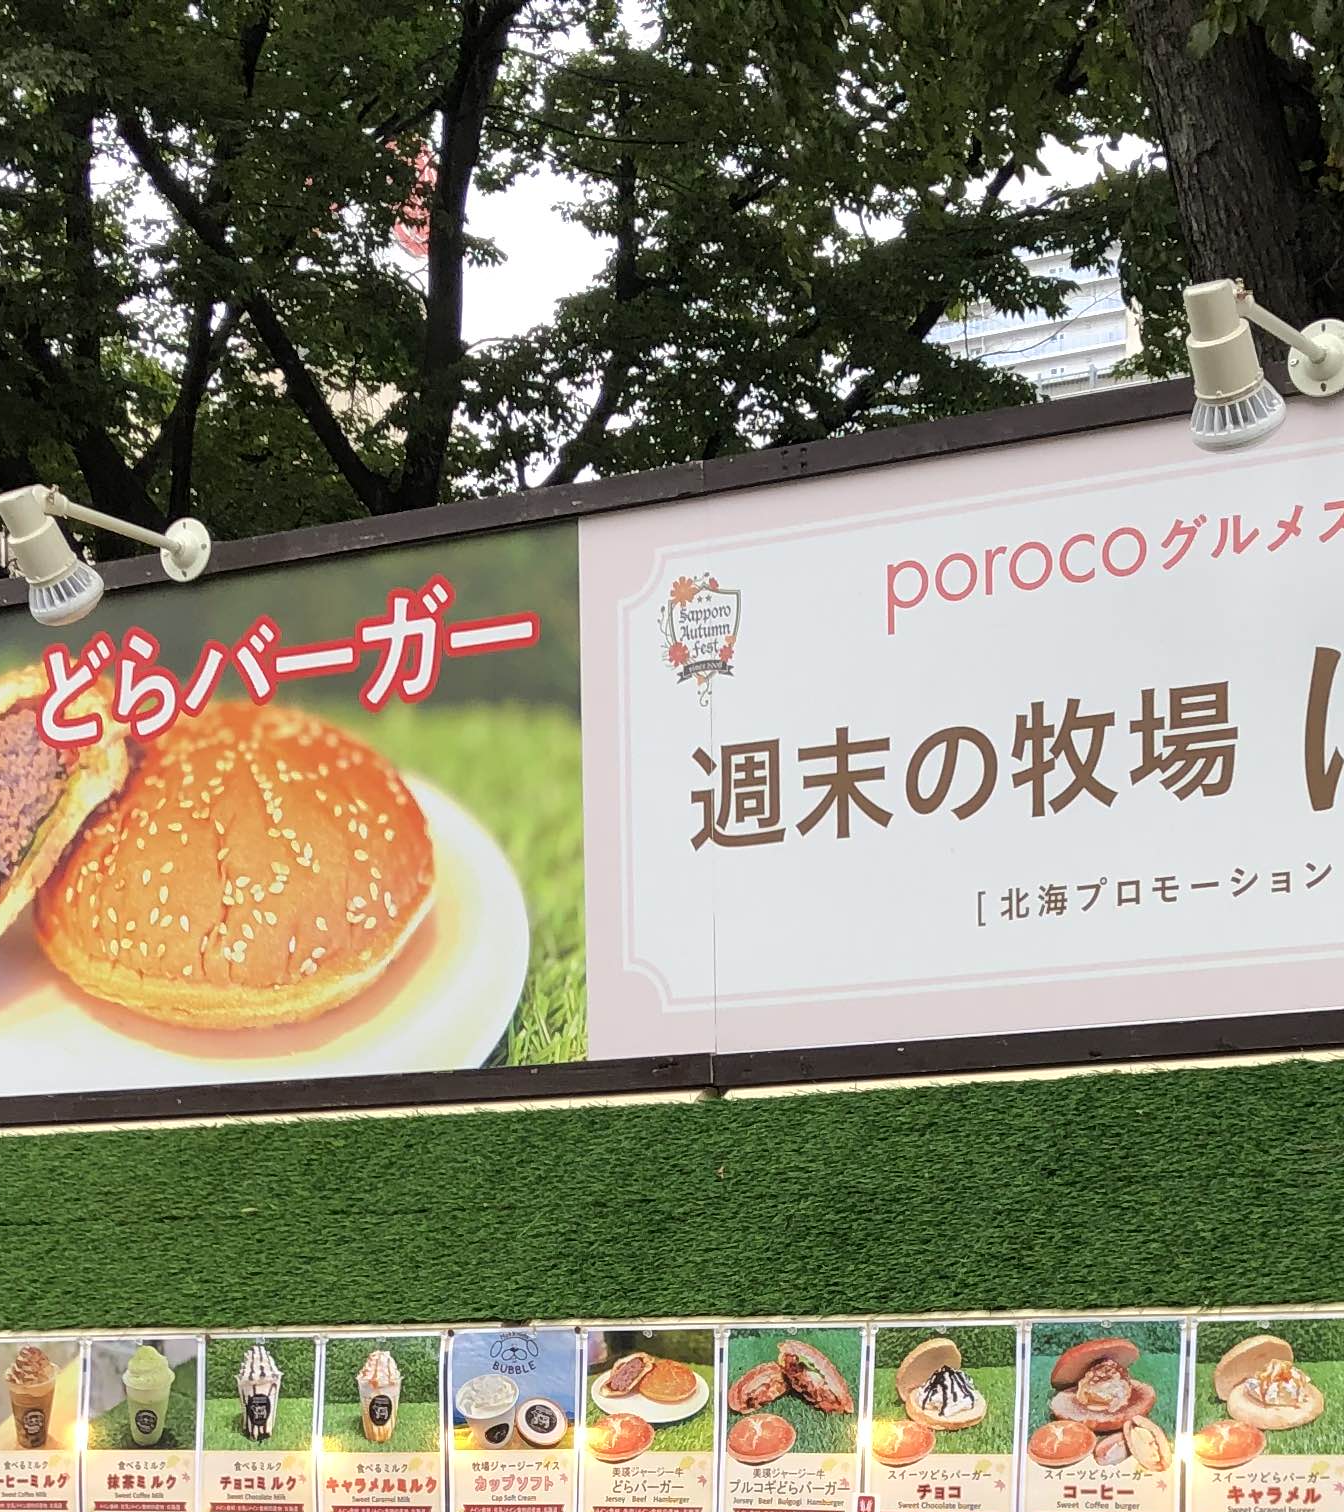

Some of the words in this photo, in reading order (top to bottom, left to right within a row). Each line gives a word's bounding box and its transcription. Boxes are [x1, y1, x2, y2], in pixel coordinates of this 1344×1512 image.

[679, 604, 731, 624] Sapporo
[680, 623, 731, 641] Autumn
[36, 573, 542, 750] どらバーガー
[688, 680, 1239, 852] 週末の牧場
[492, 1361, 537, 1375] BUBBLE
[107, 1474, 177, 1489] 抹茶ミルク
[888, 1470, 992, 1481] スイーツどらバーガー
[1044, 1469, 1153, 1481] スイーツどらバーガー
[1212, 1472, 1330, 1484] スイーツどらバーガー
[219, 1476, 297, 1491] チョコミルク
[326, 1477, 437, 1493] キャラメルミルク
[474, 1475, 554, 1492] カップソフト
[612, 1480, 685, 1494] どらバーガー
[729, 1479, 850, 1495] ブルコギどらバーガー
[917, 1484, 962, 1500] チョコ
[1063, 1485, 1134, 1500] コーヒー
[1227, 1486, 1322, 1504] キャラメル
